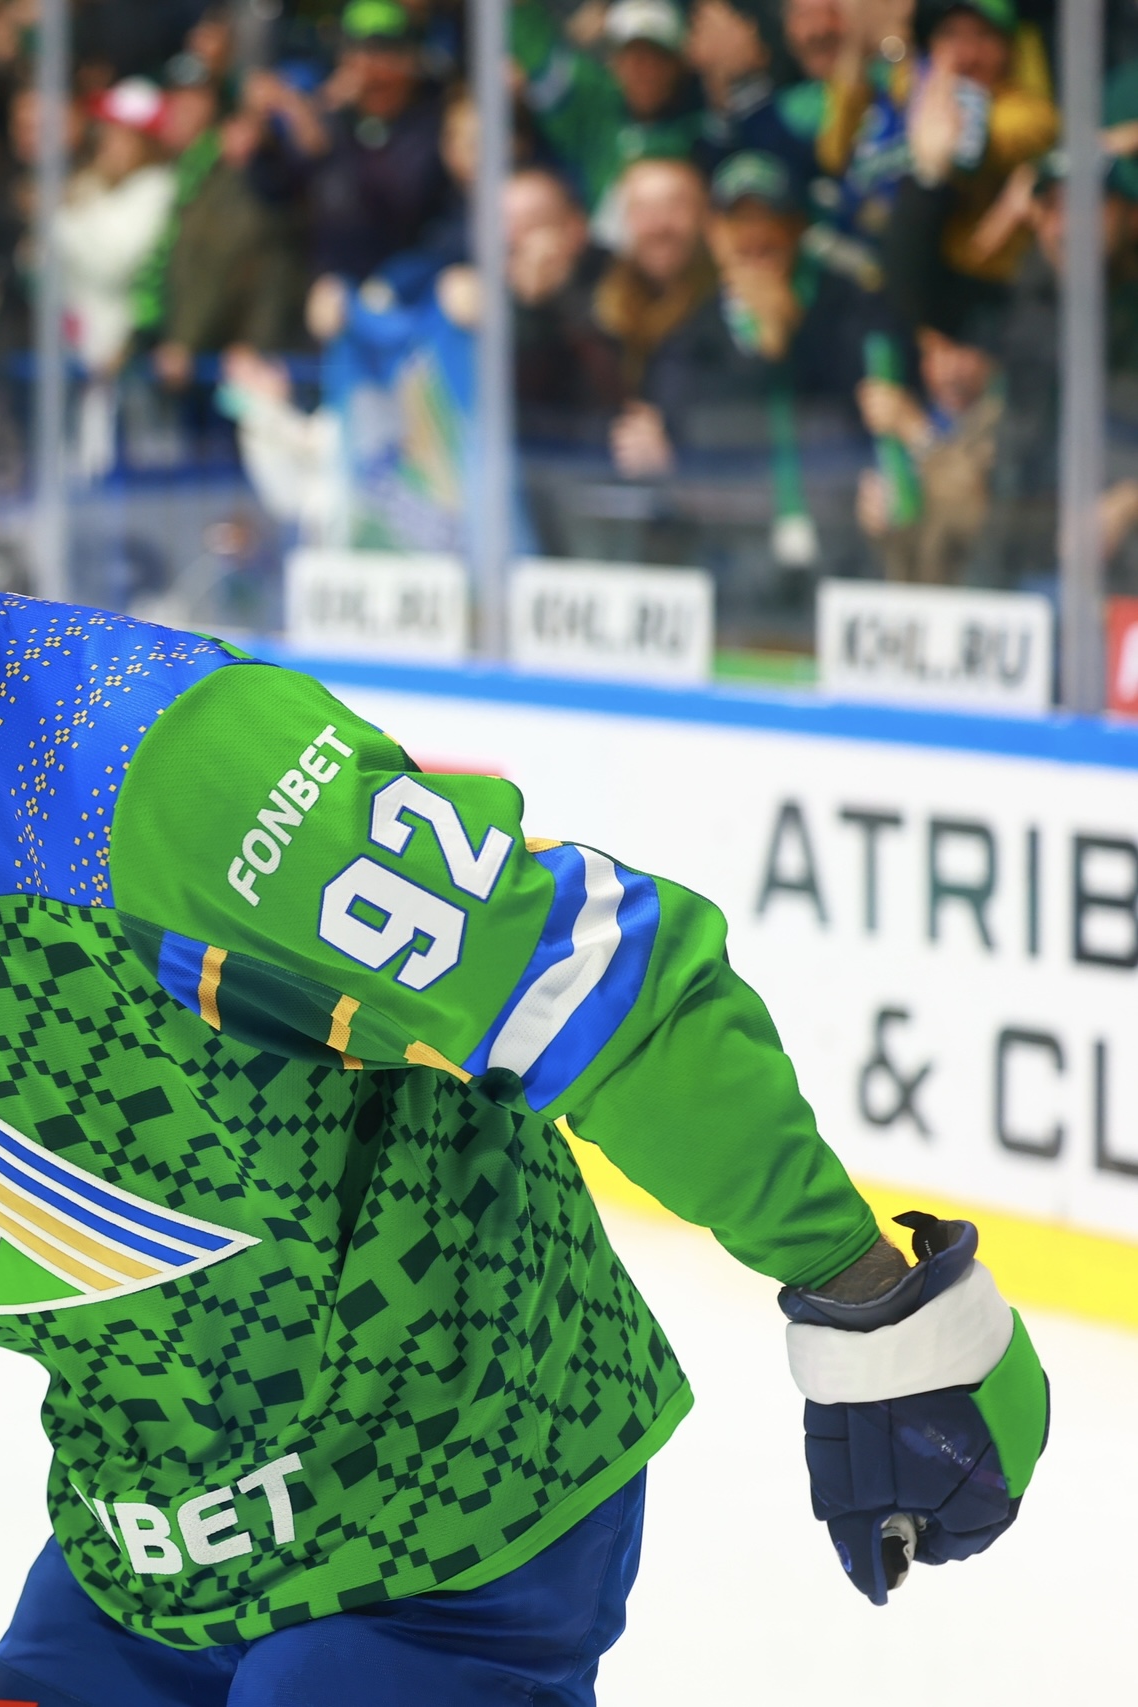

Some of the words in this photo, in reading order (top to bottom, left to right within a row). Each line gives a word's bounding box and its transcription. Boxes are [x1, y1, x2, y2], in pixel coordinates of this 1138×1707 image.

[844, 613, 1034, 688] KHL.RU
[227, 724, 354, 907] FONBET
[318, 772, 515, 992] 92
[753, 797, 1138, 970] ATRIB
[859, 1006, 935, 1146] &
